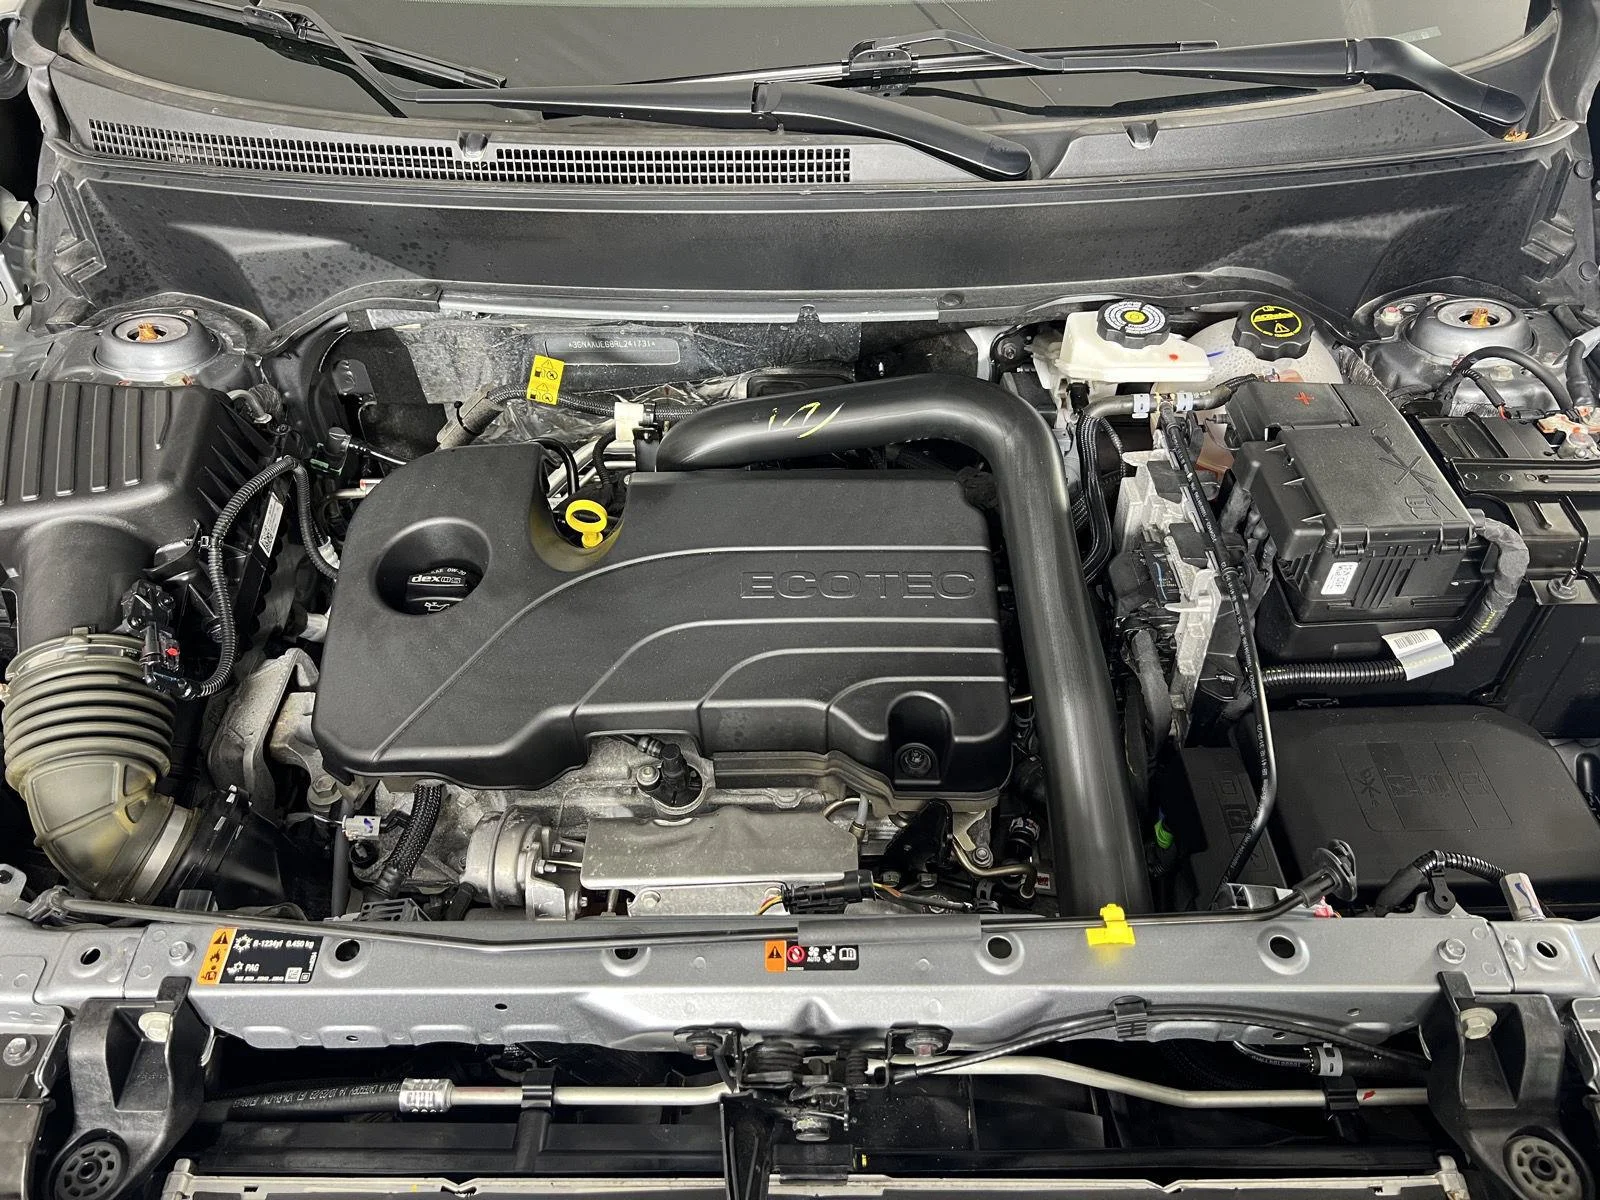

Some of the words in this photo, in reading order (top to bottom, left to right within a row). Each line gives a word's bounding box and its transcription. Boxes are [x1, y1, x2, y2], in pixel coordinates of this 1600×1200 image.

[740, 570, 977, 600] ECOTEC
[252, 939, 284, 949] R-1234yf
[285, 939, 304, 948] 0.450
[304, 940, 315, 949] kg
[244, 963, 260, 972] PAG
